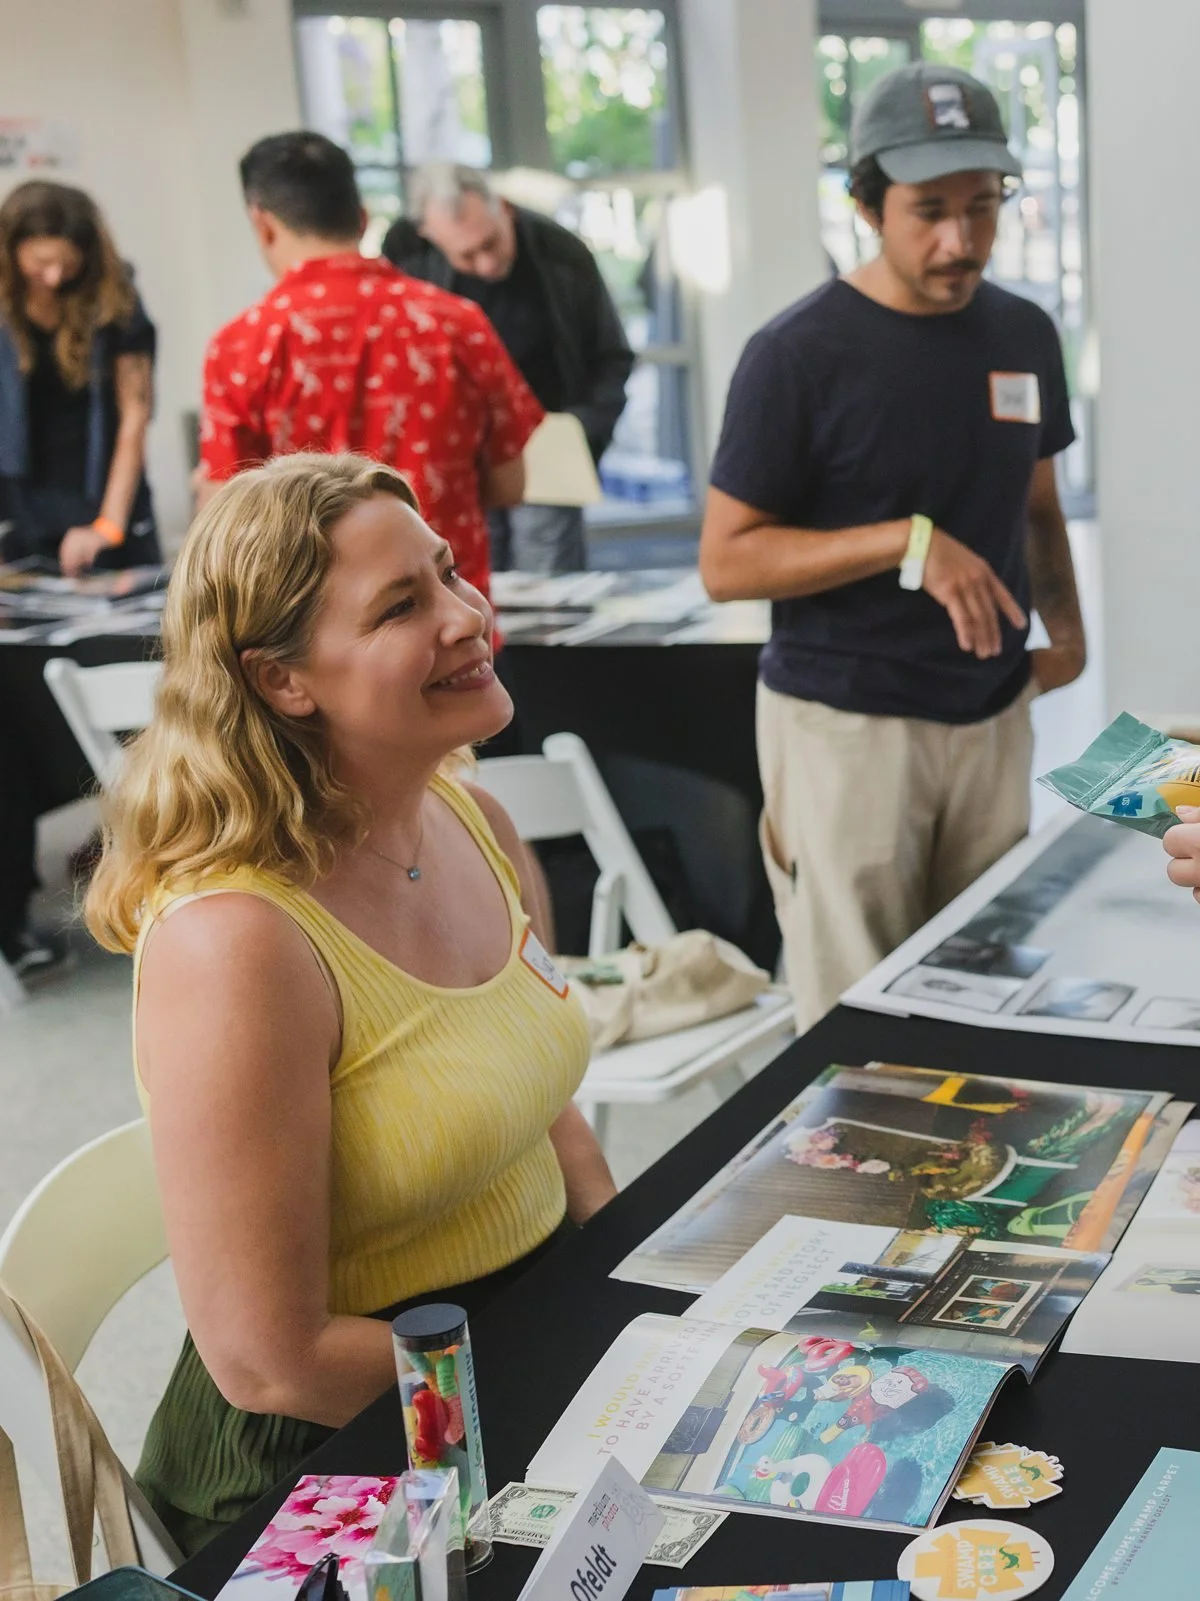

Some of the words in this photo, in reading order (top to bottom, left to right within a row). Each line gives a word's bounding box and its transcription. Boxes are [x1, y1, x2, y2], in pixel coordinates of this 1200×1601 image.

[763, 1268, 793, 1289] SAD
[778, 1248, 834, 1298] NEGLECT
[594, 1373, 639, 1428] WOULD
[597, 1434, 619, 1455] TO
[616, 1388, 650, 1428] HAVE
[647, 1325, 697, 1384] ARRIVED
[635, 1411, 656, 1430] BY
[653, 1396, 668, 1405] A
[982, 1464, 1020, 1500] SWAMP
[587, 1493, 611, 1527] medium
[601, 1503, 619, 1531] photo
[1111, 1535, 1136, 1563] HOME
[1129, 1498, 1157, 1533] SWAMP
[1152, 1463, 1180, 1498] CARPET
[570, 1544, 617, 1601] Ofeldt
[956, 1540, 976, 1590] SWAMP
